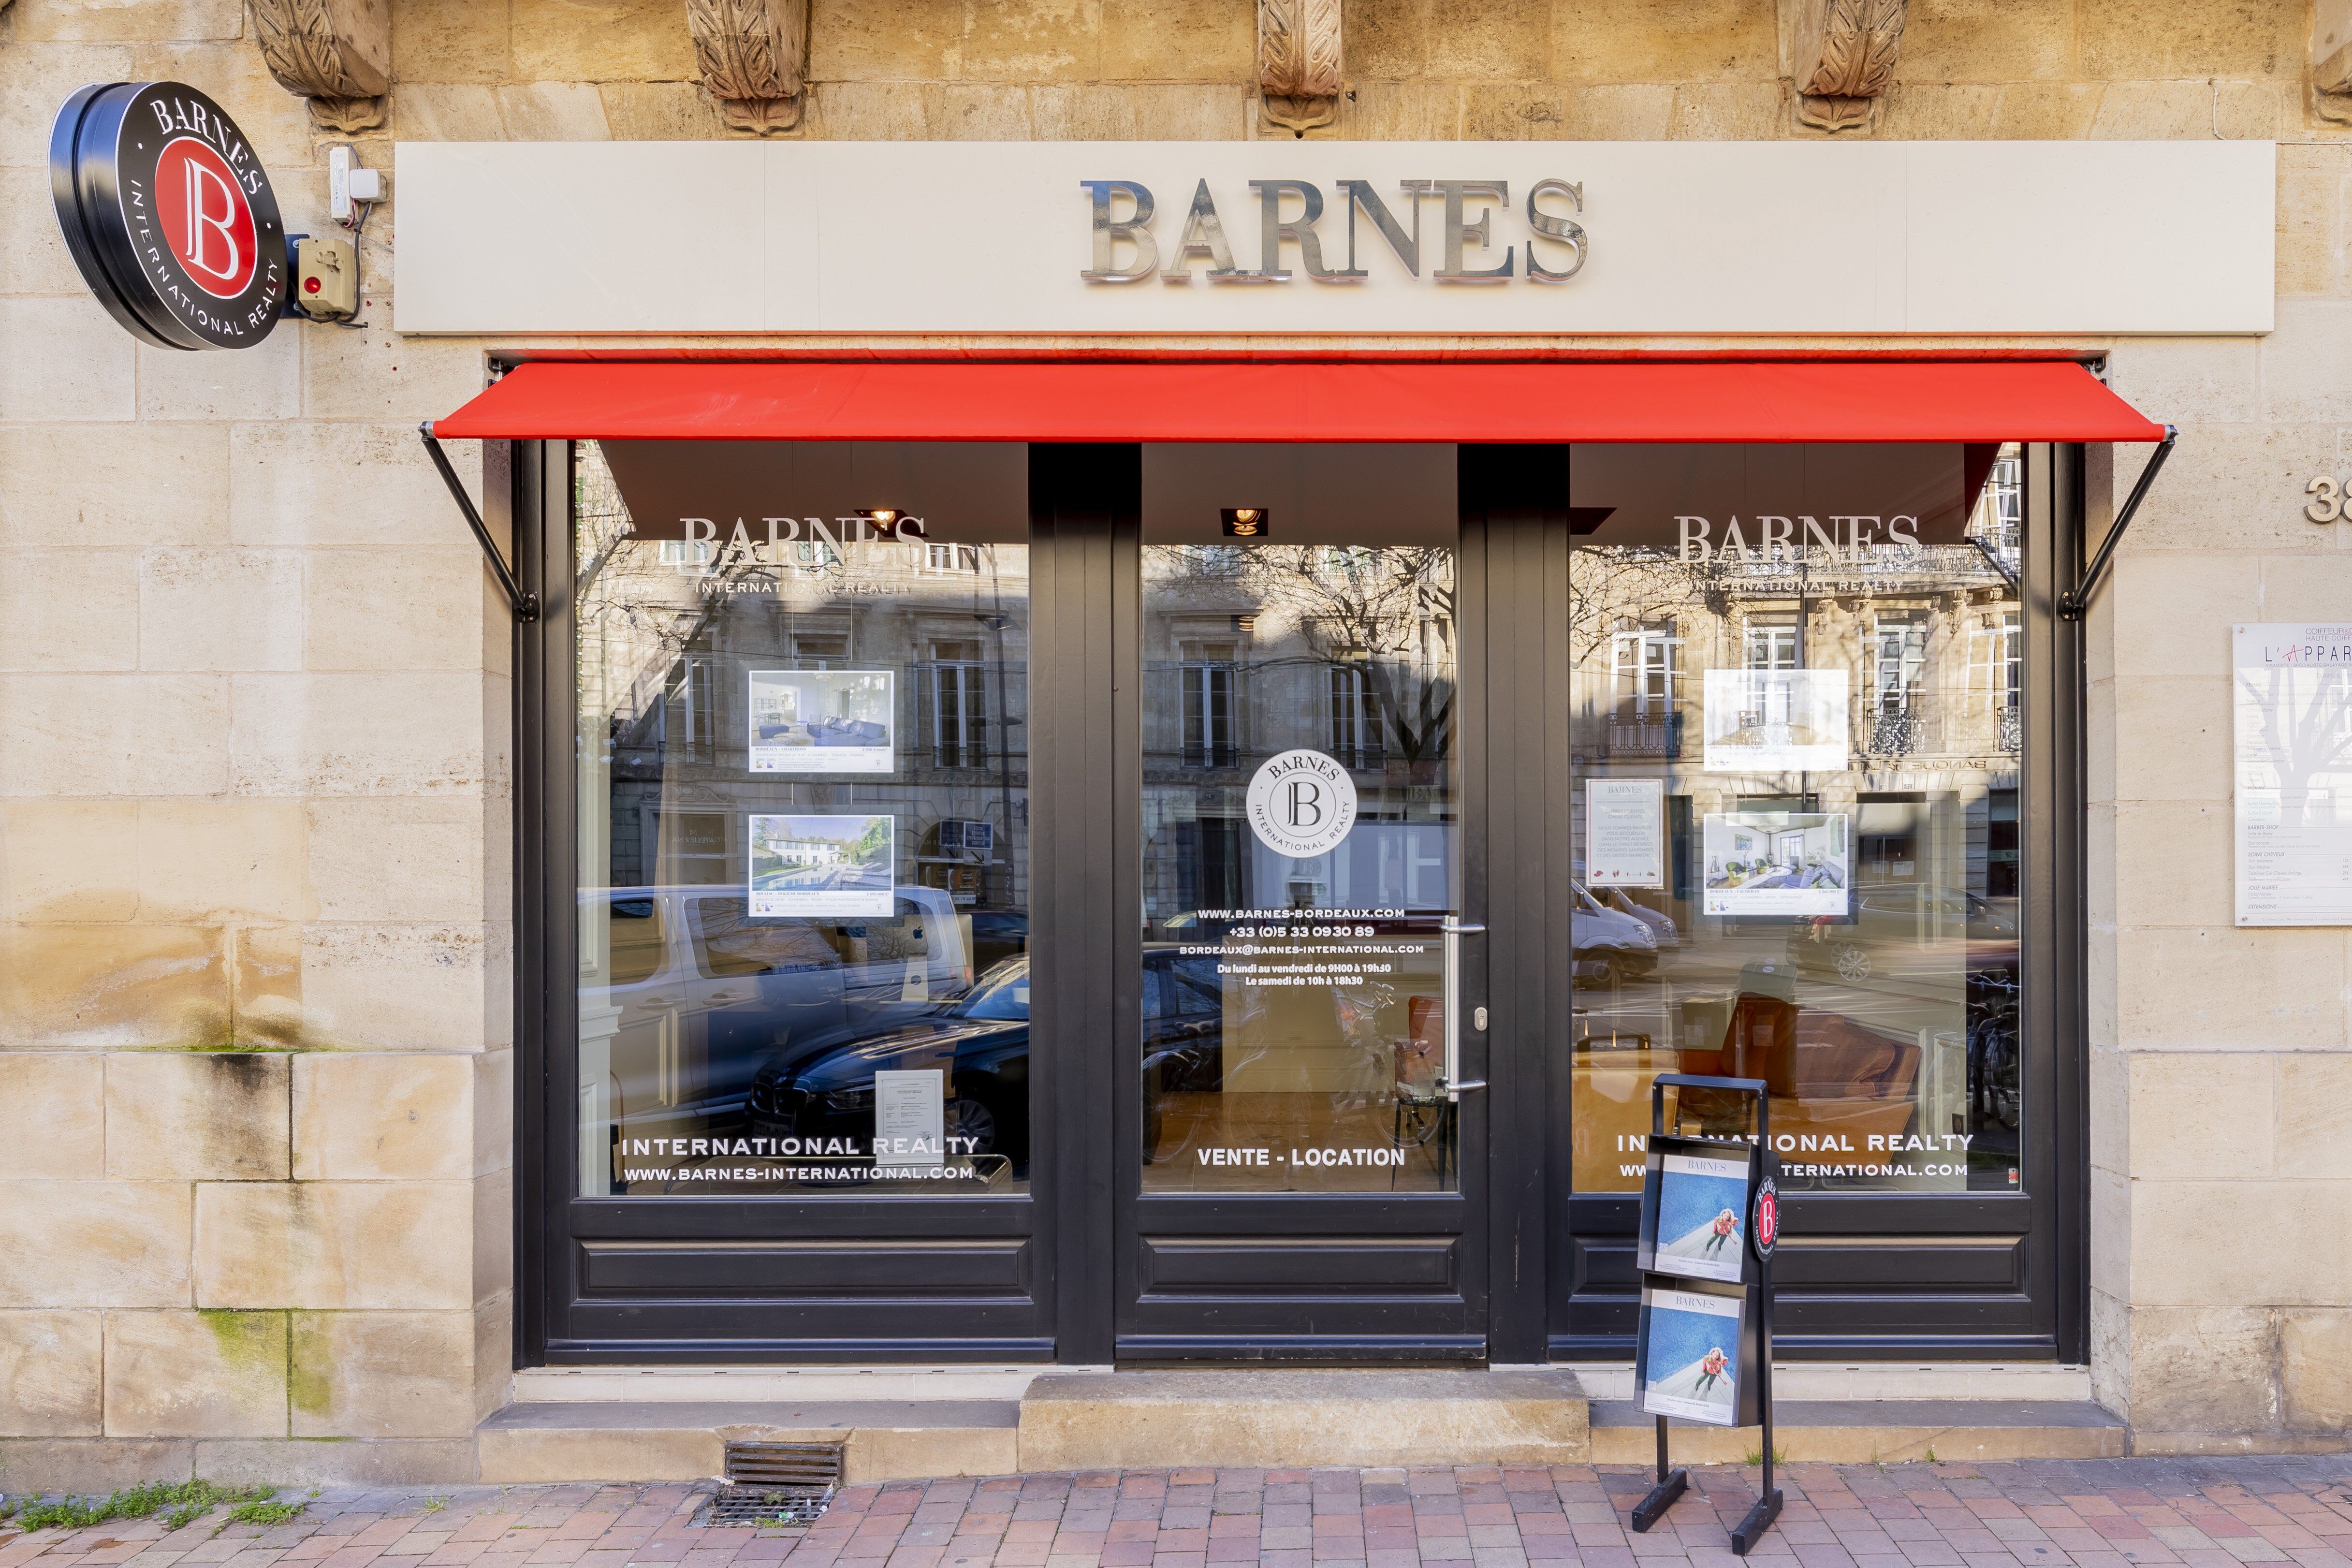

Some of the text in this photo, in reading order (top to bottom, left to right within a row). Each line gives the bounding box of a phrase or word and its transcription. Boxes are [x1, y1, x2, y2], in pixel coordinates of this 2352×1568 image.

[151, 98, 262, 194] BARNES
[1081, 178, 1588, 282] BARNES
[131, 179, 244, 335] INTERNATIONAL
[248, 258, 278, 328] REALTY
[2303, 476, 2352, 524] 3
[680, 516, 926, 567] BARNES
[1674, 515, 1919, 564] BARNES
[696, 582, 911, 593] INTERNATIONAL REALTY
[1691, 580, 1904, 591] INTERNATIONAL REALTY
[1267, 756, 1340, 781] BARNES
[1287, 782, 1321, 826] B
[1256, 801, 1349, 850] INTERNATIONAL REALTY
[1198, 909, 1404, 919] WWW.BARNES-BORDEAUX.COM
[1229, 926, 1255, 938] +33
[1259, 926, 1286, 938] (0)5
[1290, 926, 1309, 938] 33
[1355, 926, 1374, 938] 89
[1180, 945, 1424, 955] BORDEAUX@BARNES-INTERNATIONAL.COM
[1217, 964, 1231, 973] Du
[1233, 964, 1257, 973] lundi
[1271, 964, 1313, 973] vendredi
[1315, 964, 1327, 973] de
[1328, 964, 1352, 973] 9H00
[1354, 964, 1360, 973] à
[1362, 964, 1391, 973] 19h30
[1245, 976, 1363, 985] Le samedi de 10h à 18h30
[622, 1138, 979, 1156] INTERNATIONAL REALTY
[1869, 1134, 1973, 1151] REALTY
[1197, 1148, 1270, 1166] VENTE
[1292, 1148, 1405, 1166] LOCATION
[1688, 1160, 1726, 1172] BARNES
[625, 1167, 973, 1181] WWW.BARNES-INTERNATIONAL.COM
[1758, 1180, 1776, 1202] BARNES
[1676, 1296, 1715, 1309] BARNES
